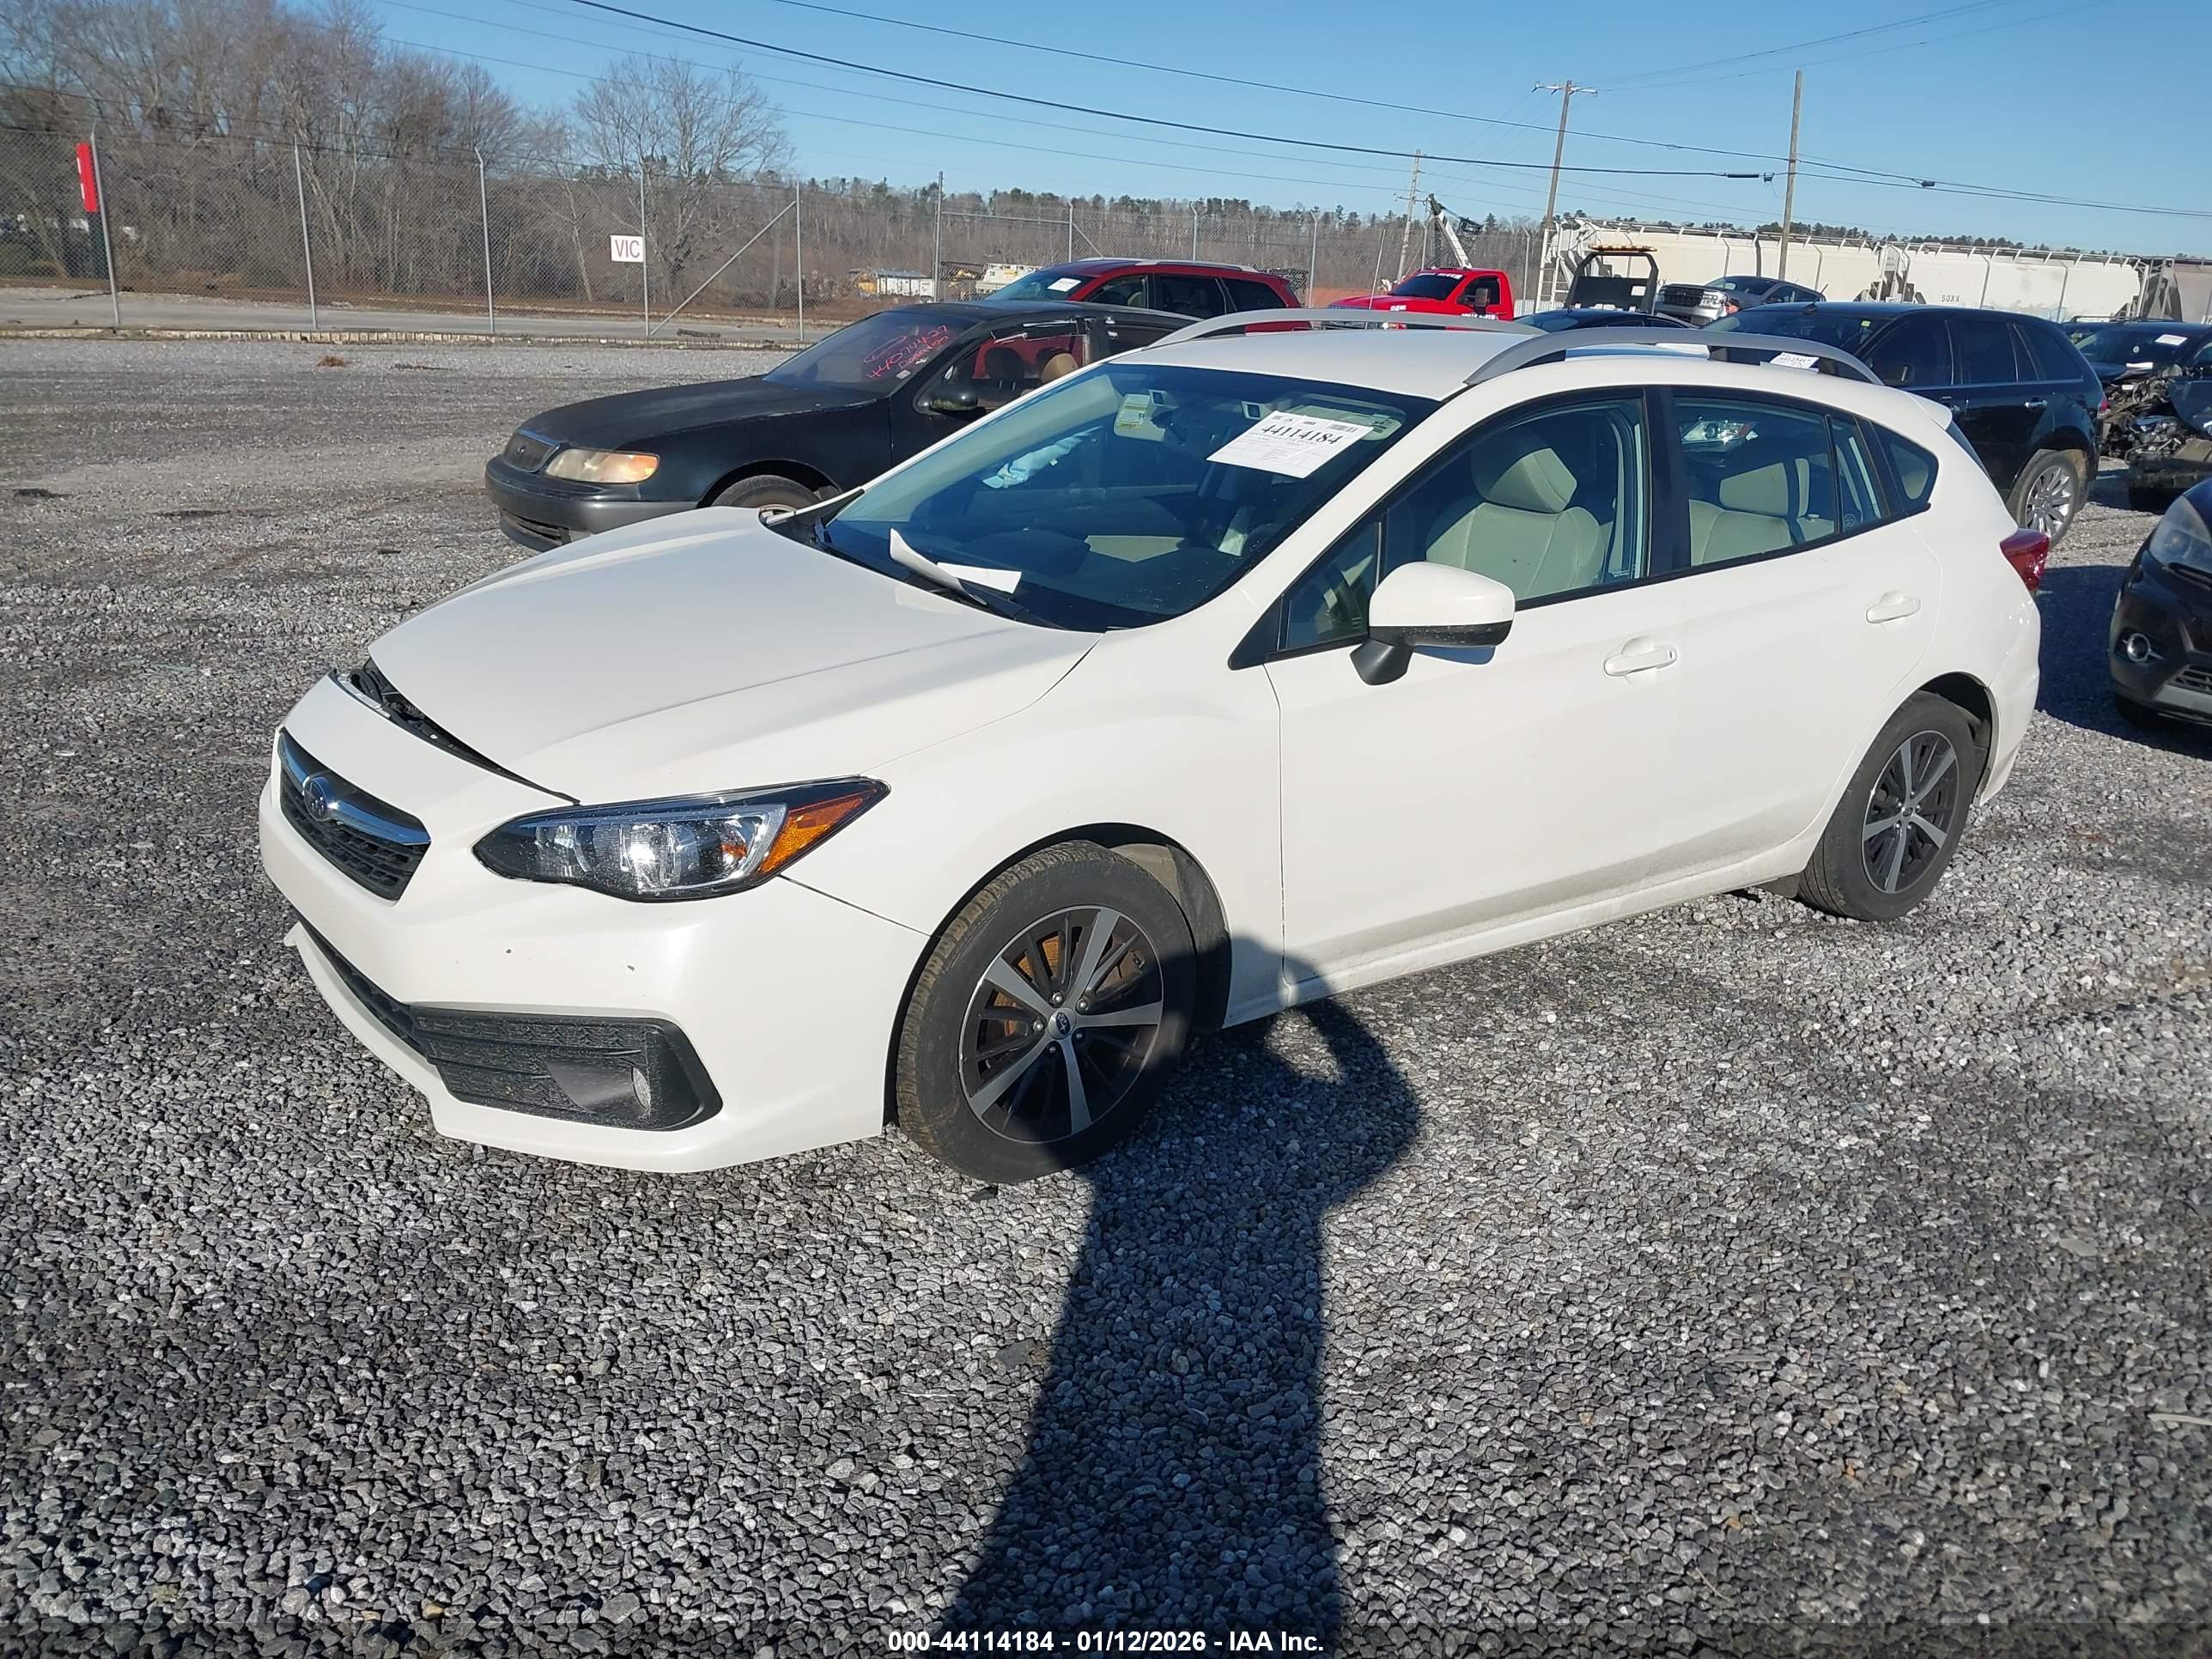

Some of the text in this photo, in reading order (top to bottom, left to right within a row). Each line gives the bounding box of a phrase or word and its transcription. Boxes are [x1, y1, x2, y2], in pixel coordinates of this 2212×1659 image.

[614, 239, 641, 258] VIC
[1941, 295, 1960, 303] SOXX
[1261, 424, 1342, 445] 44114184
